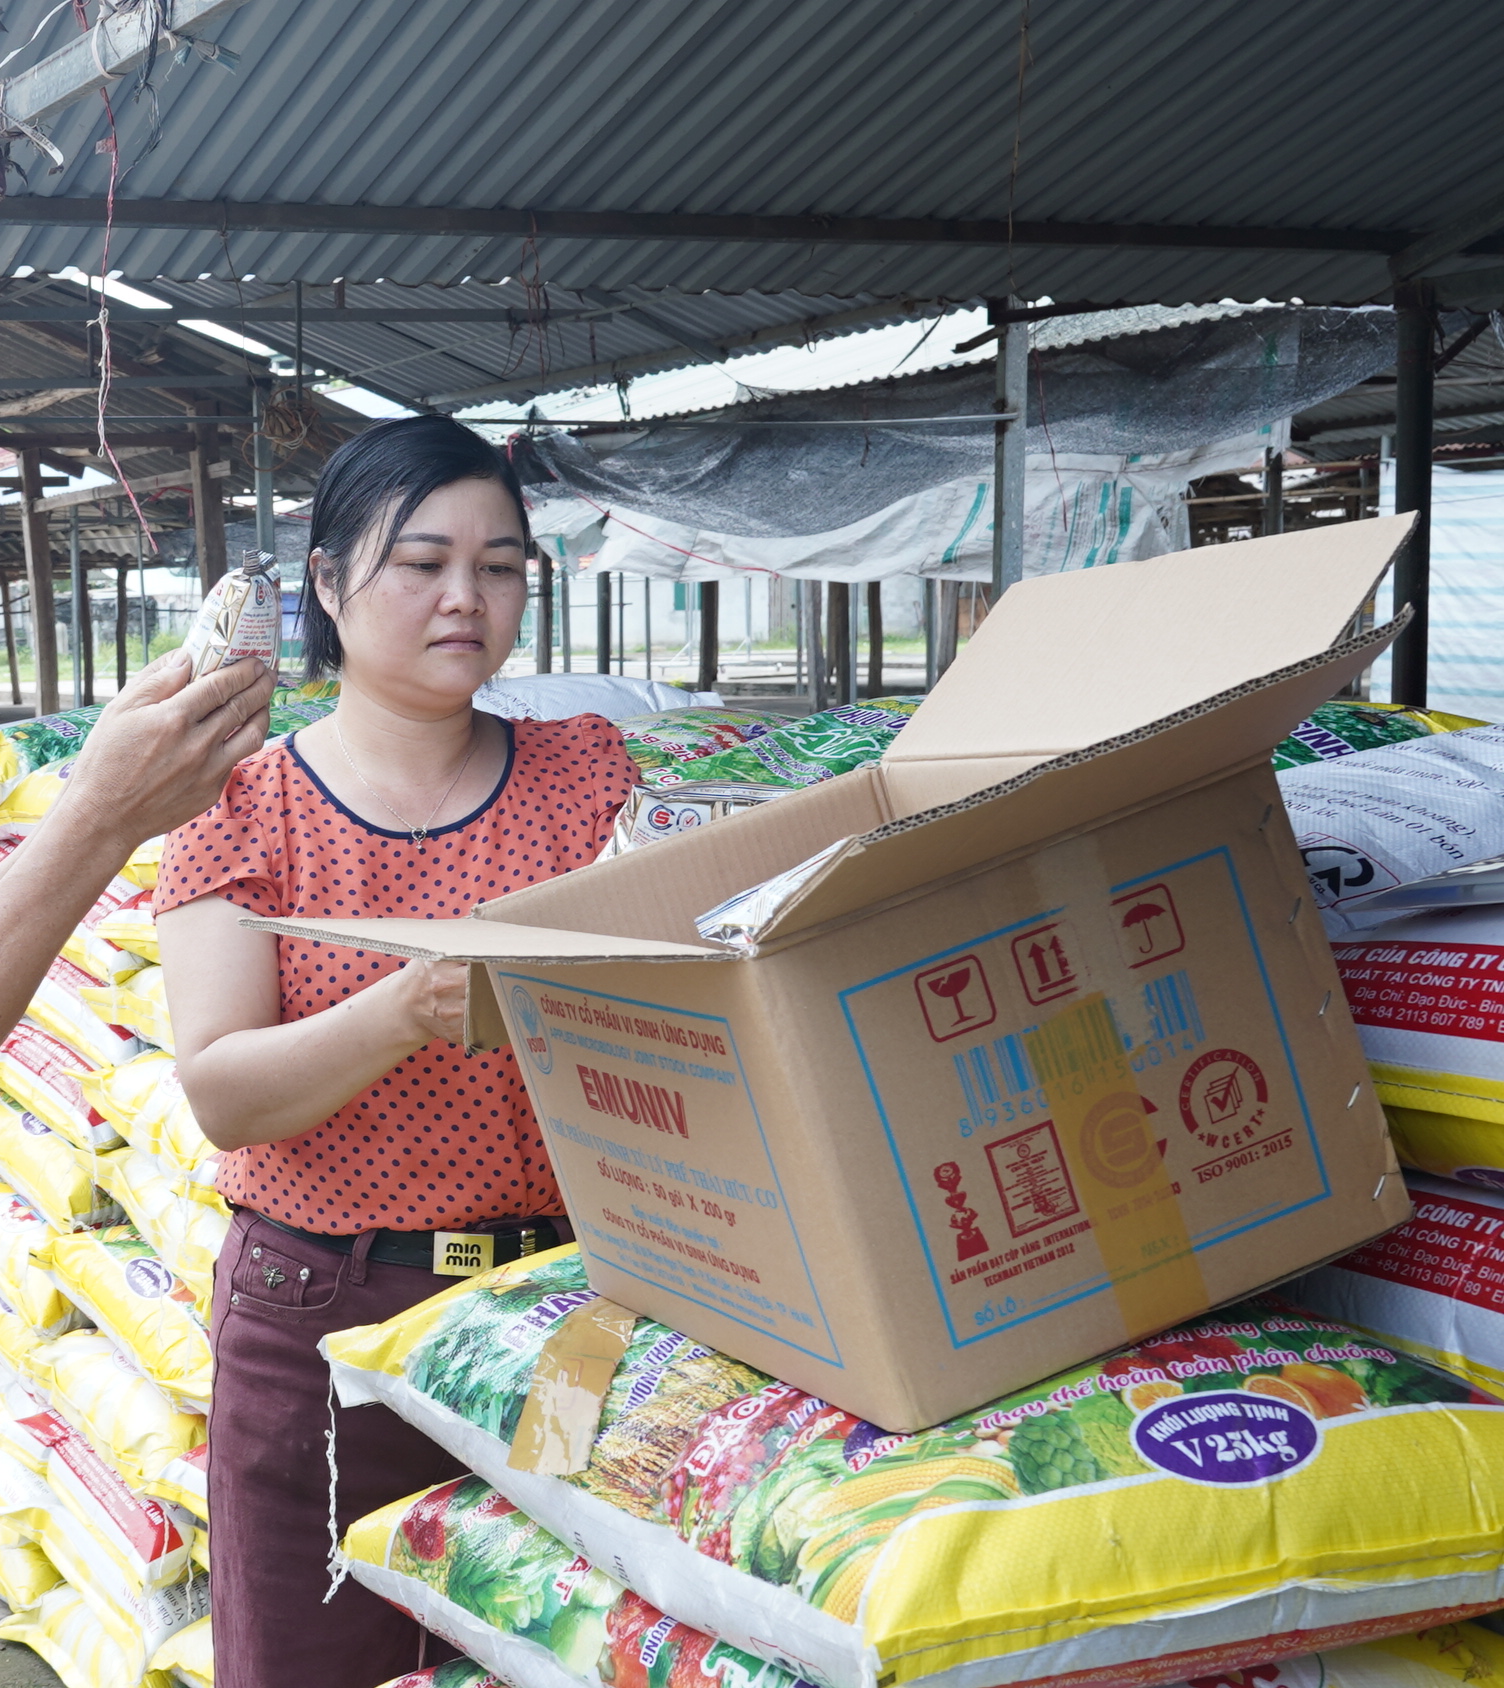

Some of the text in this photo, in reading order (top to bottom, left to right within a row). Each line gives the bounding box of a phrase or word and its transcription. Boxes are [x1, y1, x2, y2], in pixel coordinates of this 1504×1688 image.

[1365, 944, 1407, 964] CỦA
[1408, 947, 1468, 968] CÔNG
[1468, 952, 1499, 971] TY
[1383, 970, 1409, 984] TẠI
[1408, 971, 1458, 988] CÔNG
[1458, 976, 1481, 991] TY
[1354, 986, 1375, 1000] Địa
[1407, 991, 1436, 1007] Đạo
[1438, 994, 1468, 1009] Đức
[539, 994, 726, 1055] CÔNG TY CỔ PHẦN VI SINH ỨNG DỤNG
[1349, 1005, 1365, 1016] ax:
[1370, 1006, 1393, 1018] +84
[1396, 1008, 1427, 1024] 2113
[1431, 1012, 1457, 1027] 607
[1459, 1015, 1484, 1030] 789
[550, 1028, 736, 1084] APPLIED MICROBIOLOGY JOINT STOCK COMPANY
[1180, 1051, 1264, 1112] CERTIFICATION
[577, 1065, 689, 1138] EMUNIV
[959, 1118, 974, 1138] 8
[1205, 1114, 1263, 1150] WCERT
[606, 1141, 629, 1162] SINH
[663, 1161, 691, 1184] PHẾ
[754, 1188, 778, 1208] CƠ
[1197, 1134, 1293, 1184] ISO 9001: 2015
[597, 1158, 612, 1178] SỐ
[612, 1168, 646, 1192] LƯỢNG
[652, 1183, 667, 1200] 50
[667, 1192, 684, 1207] gói
[686, 1194, 698, 1211] X
[700, 1200, 724, 1219] 200
[723, 1210, 736, 1226] gr
[1416, 1203, 1502, 1235] CÔNG TY
[446, 1242, 481, 1255] min
[602, 1208, 761, 1283] CÔNG TY CỔ PHẦN VI SINH ỨNG DỤNG
[1413, 1248, 1440, 1265] Đạo
[1416, 1229, 1460, 1249] CÔNG
[1462, 1240, 1485, 1255] TY
[446, 1255, 481, 1267] min
[984, 1243, 1075, 1286] TECHMART VIETNAM 2012
[1377, 1259, 1397, 1273] +84
[1400, 1263, 1431, 1282] 2113
[1433, 1271, 1457, 1287] 607
[950, 1271, 967, 1284] SẢN
[973, 1296, 1017, 1326] SỐ LÔ
[1196, 1319, 1260, 1340] vững
[1262, 1315, 1306, 1334] của
[643, 1331, 690, 1367] THỐN
[974, 1342, 1396, 1430] Thay thế hoàn toàn phân chuồng
[1146, 1401, 1290, 1443] KHỐI LƯỢNG TỊNH
